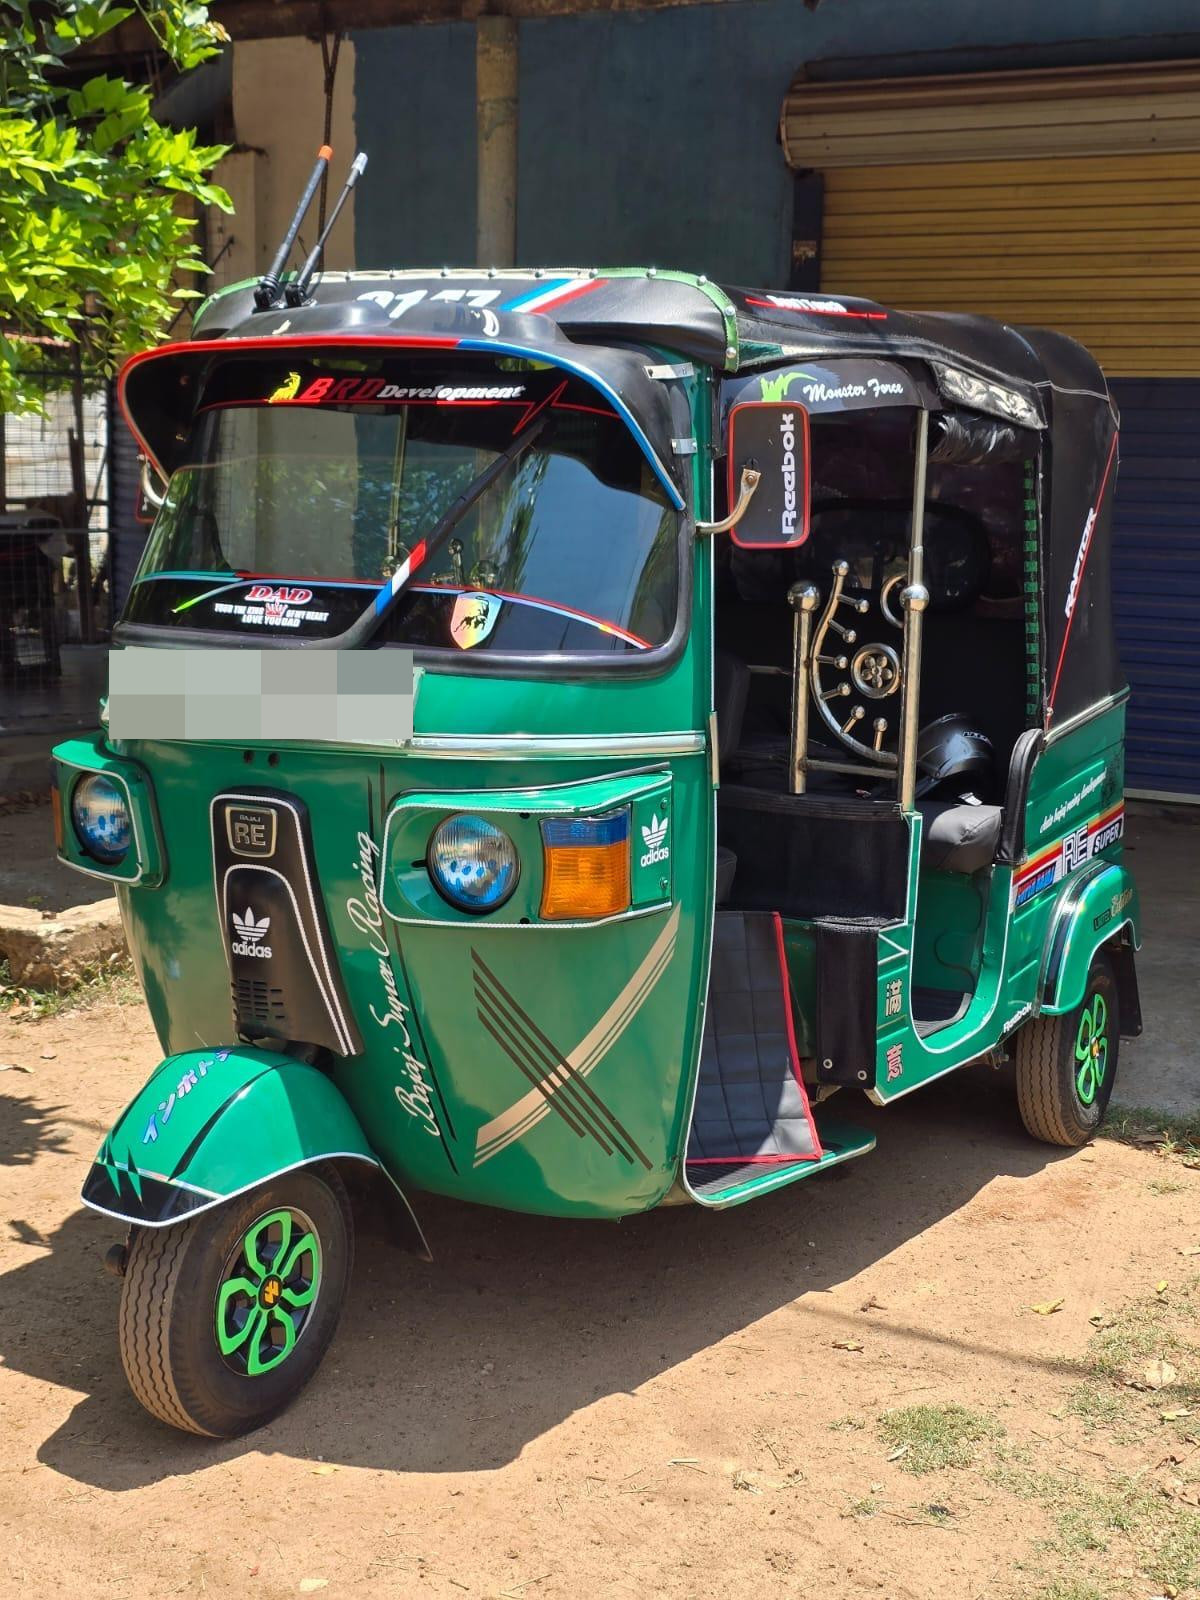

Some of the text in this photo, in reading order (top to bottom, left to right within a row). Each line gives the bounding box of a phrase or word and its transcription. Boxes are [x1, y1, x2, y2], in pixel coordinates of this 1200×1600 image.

[300, 378, 526, 401] BRD Development
[802, 378, 904, 402] Monster Force
[780, 413, 797, 534] Reebok
[244, 585, 313, 605] DAD
[242, 614, 300, 627] LOVE YOU DAD
[305, 611, 329, 622] HEART
[233, 822, 266, 846] RE
[640, 846, 669, 868] adidas
[1062, 821, 1120, 877] RE SUPER
[346, 831, 390, 957] Racing
[231, 941, 273, 959] adidas
[370, 957, 411, 1048] Super
